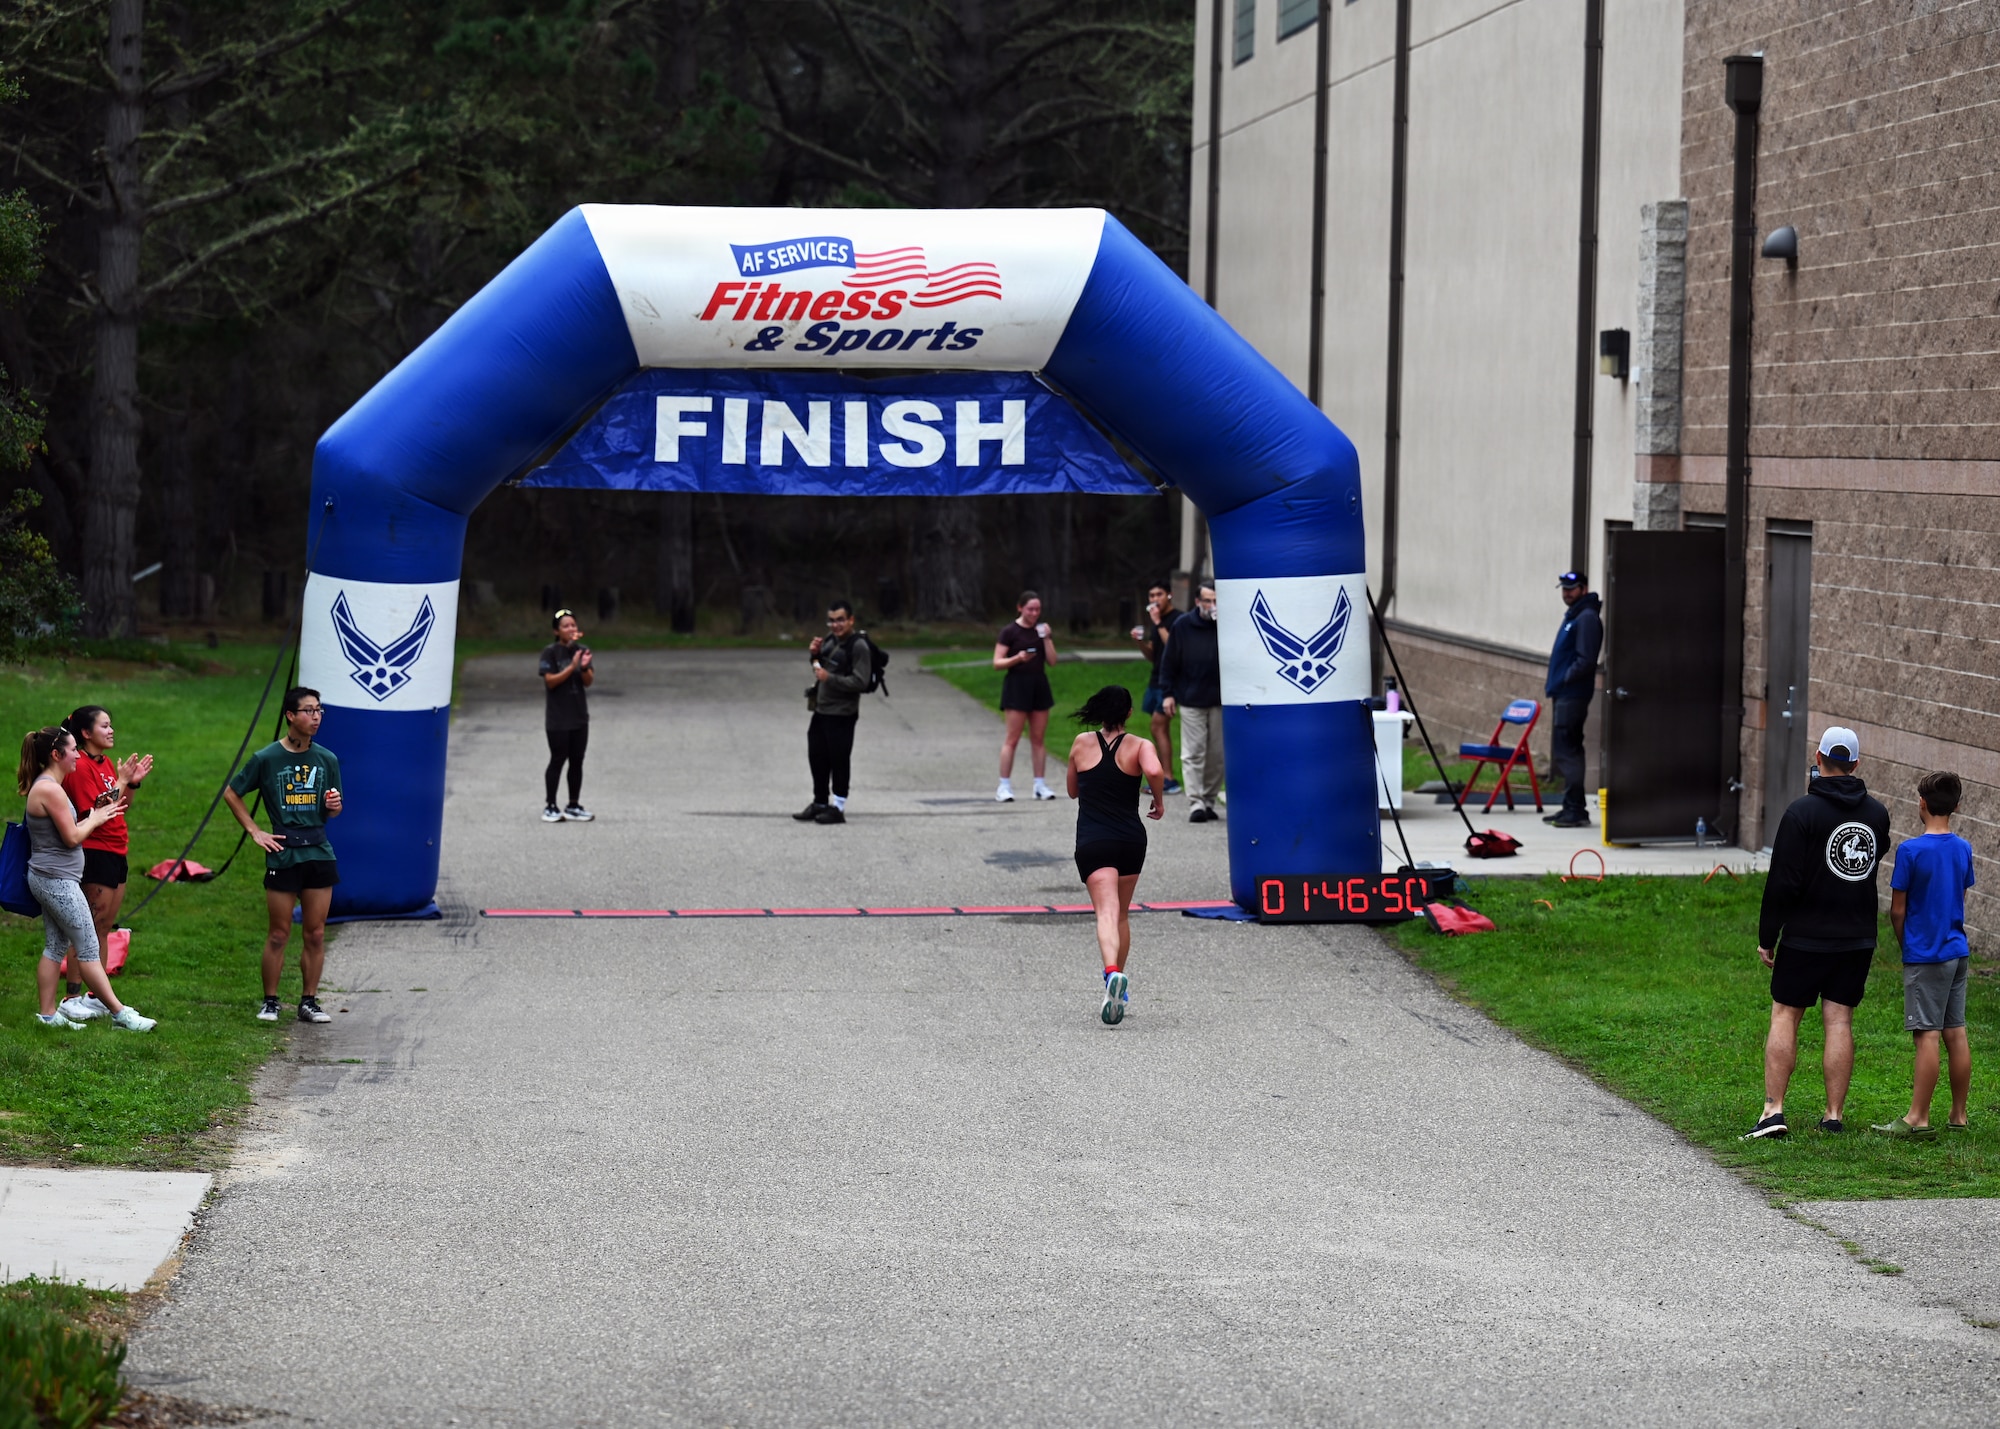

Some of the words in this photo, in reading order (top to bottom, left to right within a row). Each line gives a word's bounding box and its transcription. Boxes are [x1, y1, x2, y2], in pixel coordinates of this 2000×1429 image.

[742, 252, 766, 273] AF
[767, 241, 850, 270] SERVICES
[700, 282, 908, 321] Fitness
[744, 326, 785, 352] &
[794, 321, 984, 356] Sports
[654, 396, 1026, 467] FINISH
[286, 794, 317, 804] YOSEMITE
[1851, 828, 1872, 841] CAPITAL
